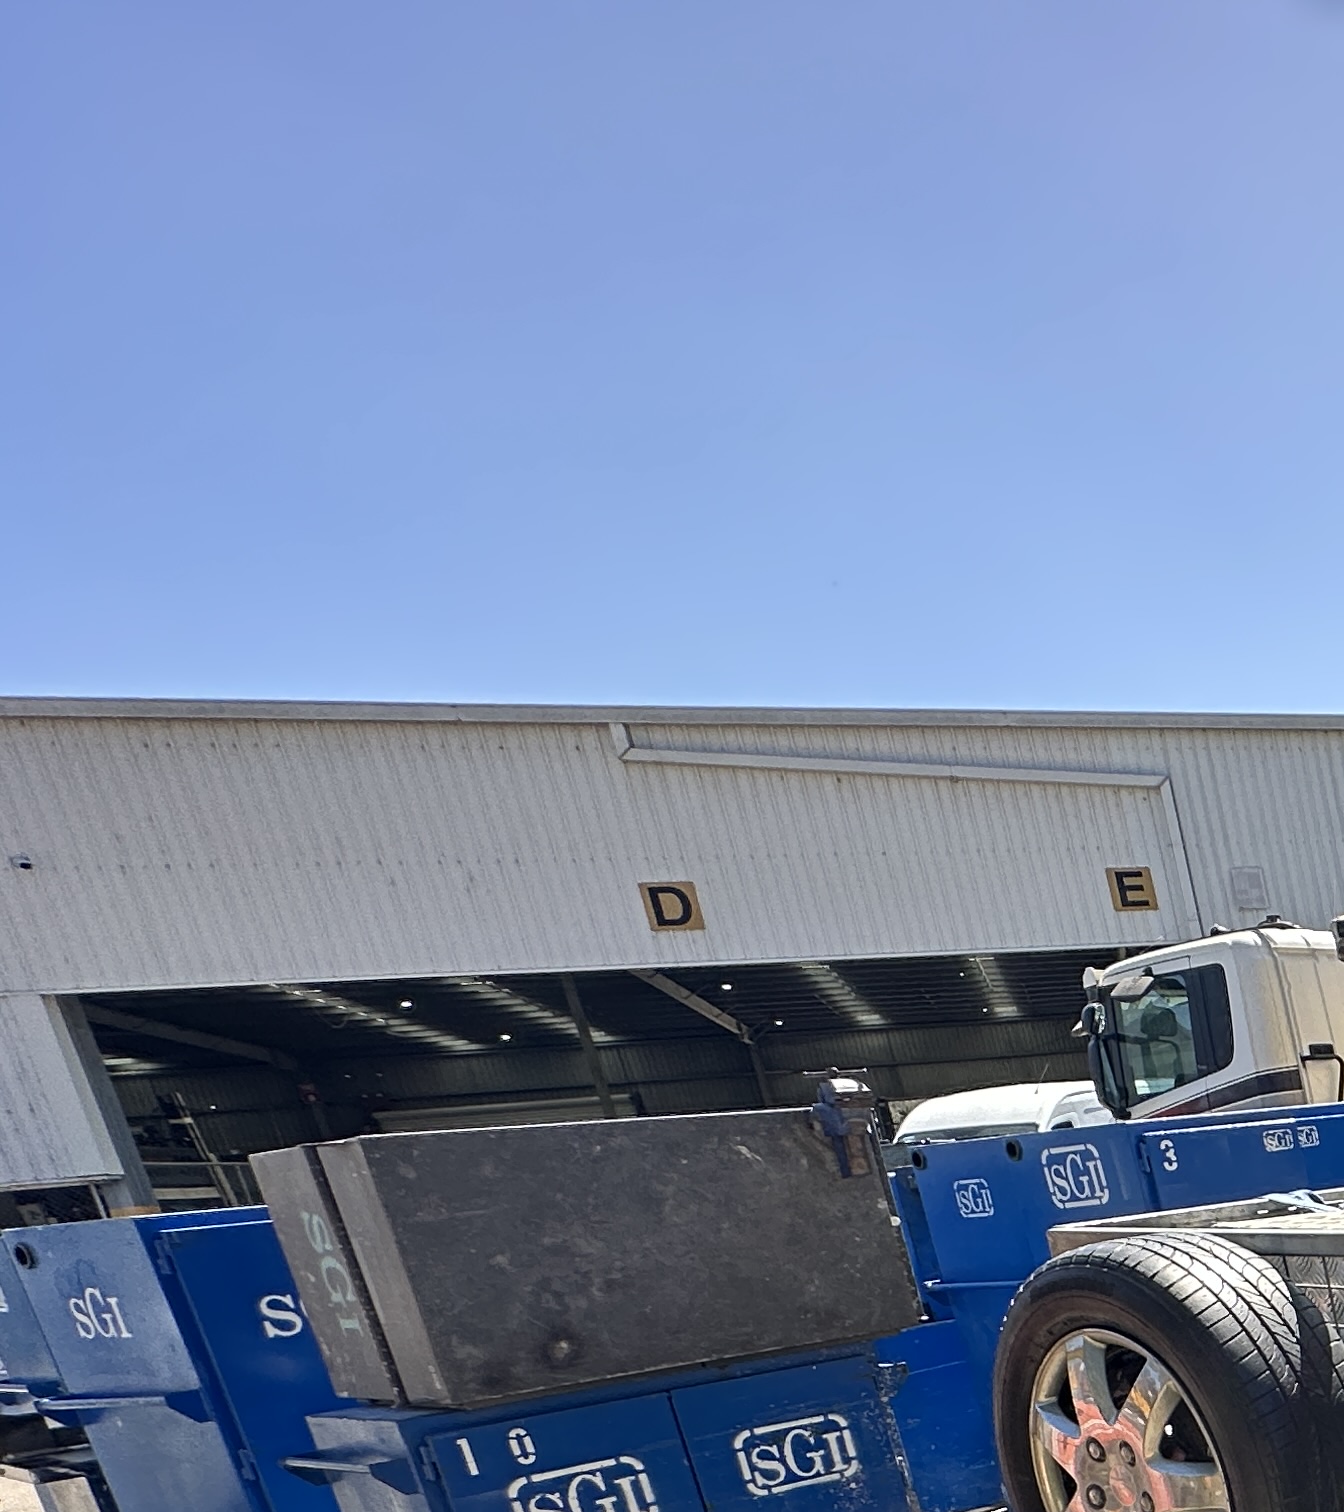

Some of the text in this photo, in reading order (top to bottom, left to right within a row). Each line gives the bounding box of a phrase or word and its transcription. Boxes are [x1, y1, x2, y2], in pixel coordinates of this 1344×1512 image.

[647, 886, 693, 926] D
[1114, 870, 1151, 907] E
[1160, 1139, 1178, 1172] 3
[1267, 1132, 1292, 1149] SGI
[1050, 1153, 1104, 1202] SGI
[959, 1184, 992, 1213] SGI
[69, 1287, 132, 1339] SGI
[750, 1428, 848, 1487] SGI
